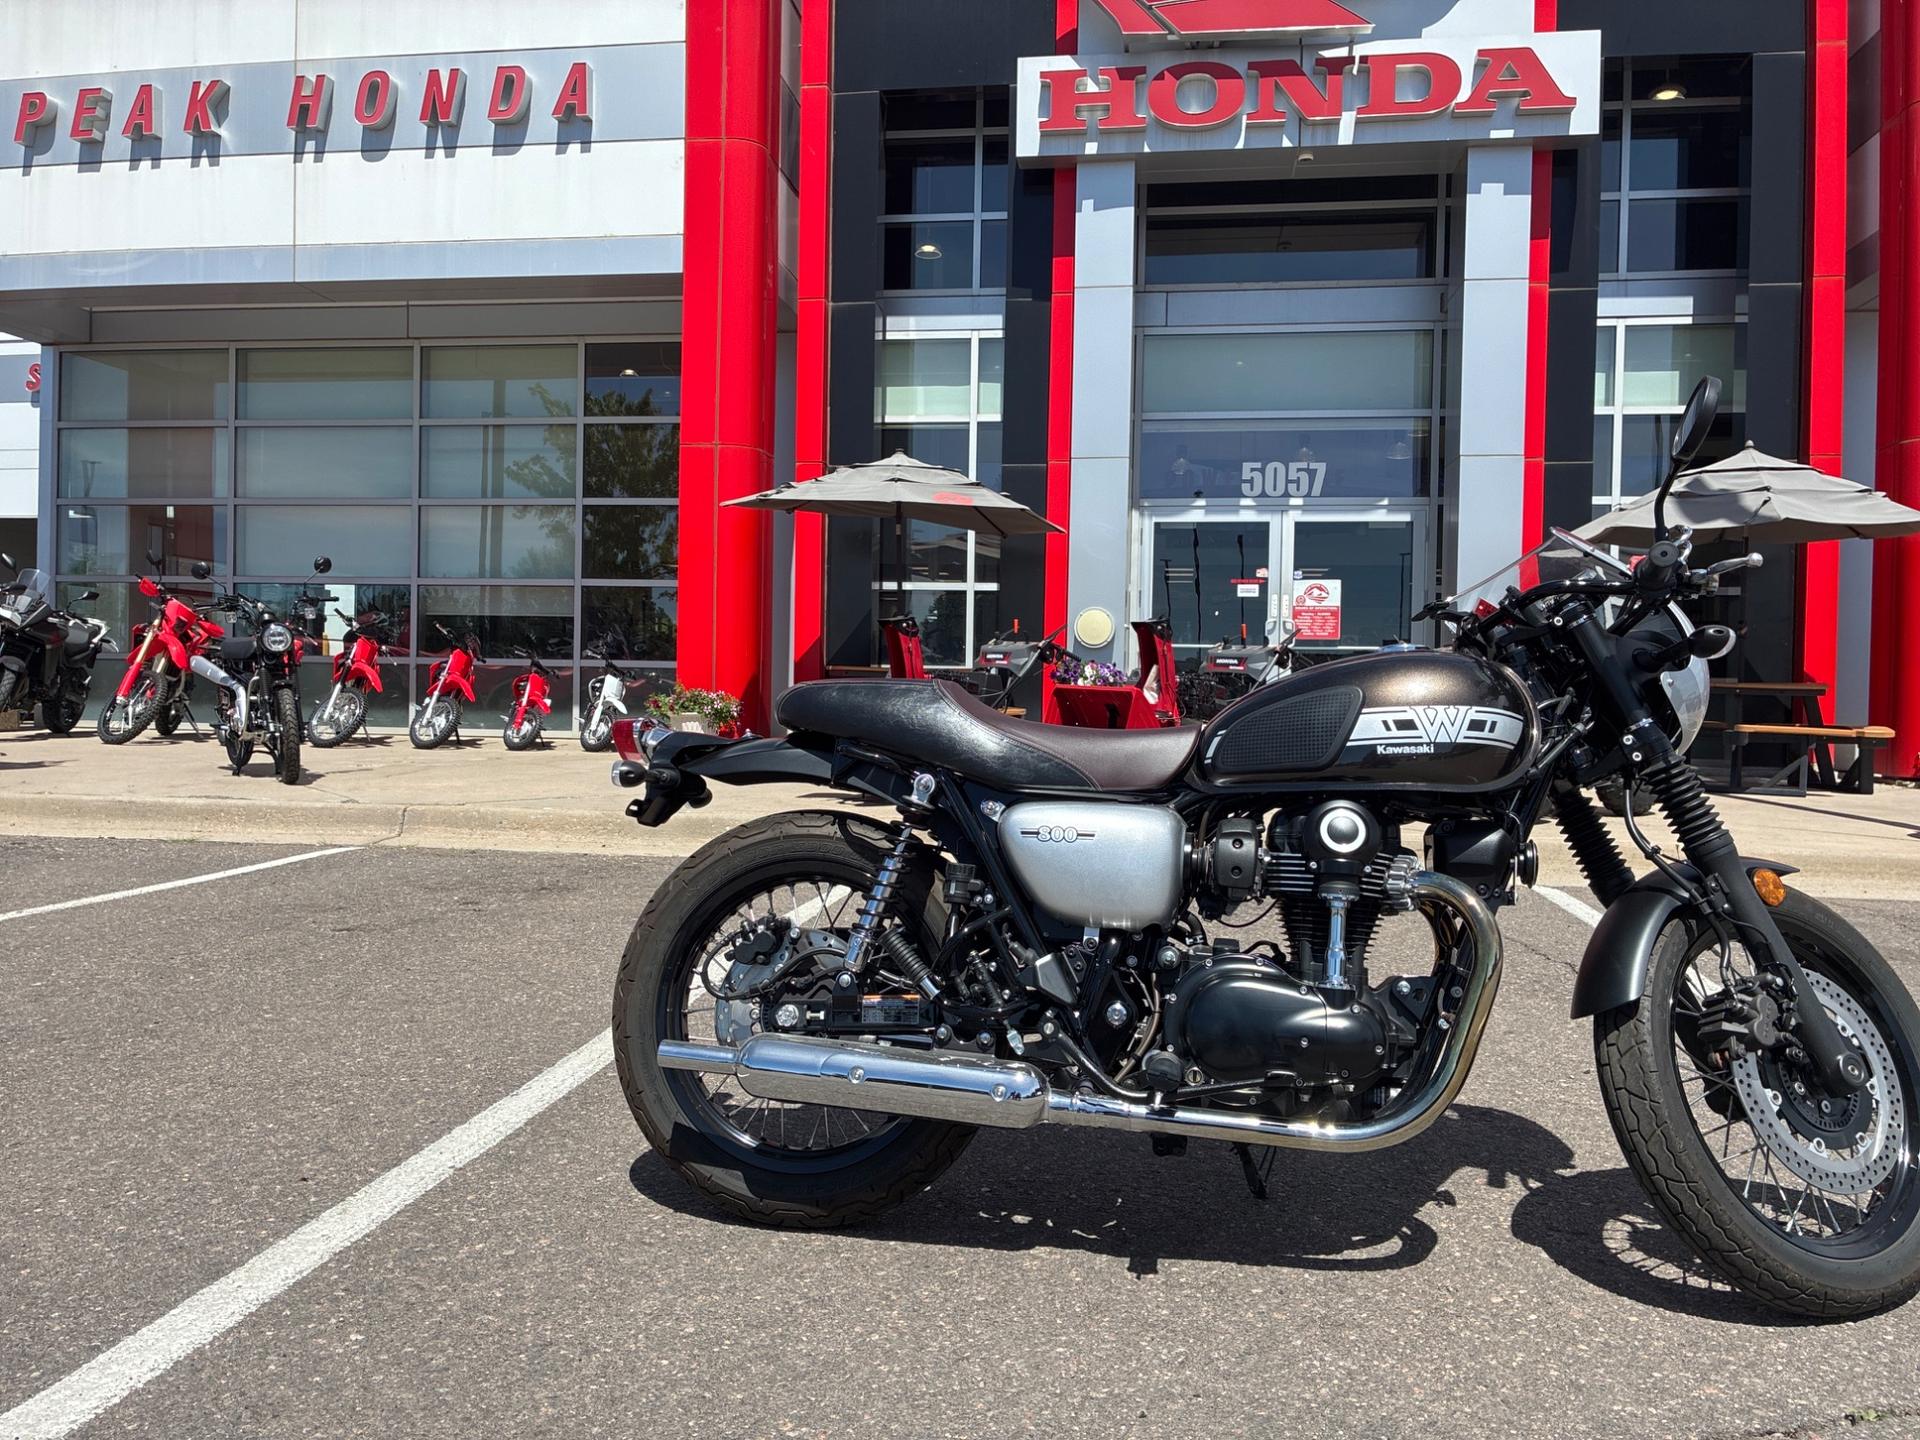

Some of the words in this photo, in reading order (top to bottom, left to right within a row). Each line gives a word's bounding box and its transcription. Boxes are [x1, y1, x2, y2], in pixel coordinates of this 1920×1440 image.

[13, 79, 229, 147] PEAK
[286, 61, 594, 132] HONDA
[1039, 46, 1577, 131] HONDA
[1241, 461, 1327, 497] 5057
[1409, 705, 1473, 743] W
[1376, 743, 1434, 755] Kawasaki
[1036, 825, 1078, 843] 800
